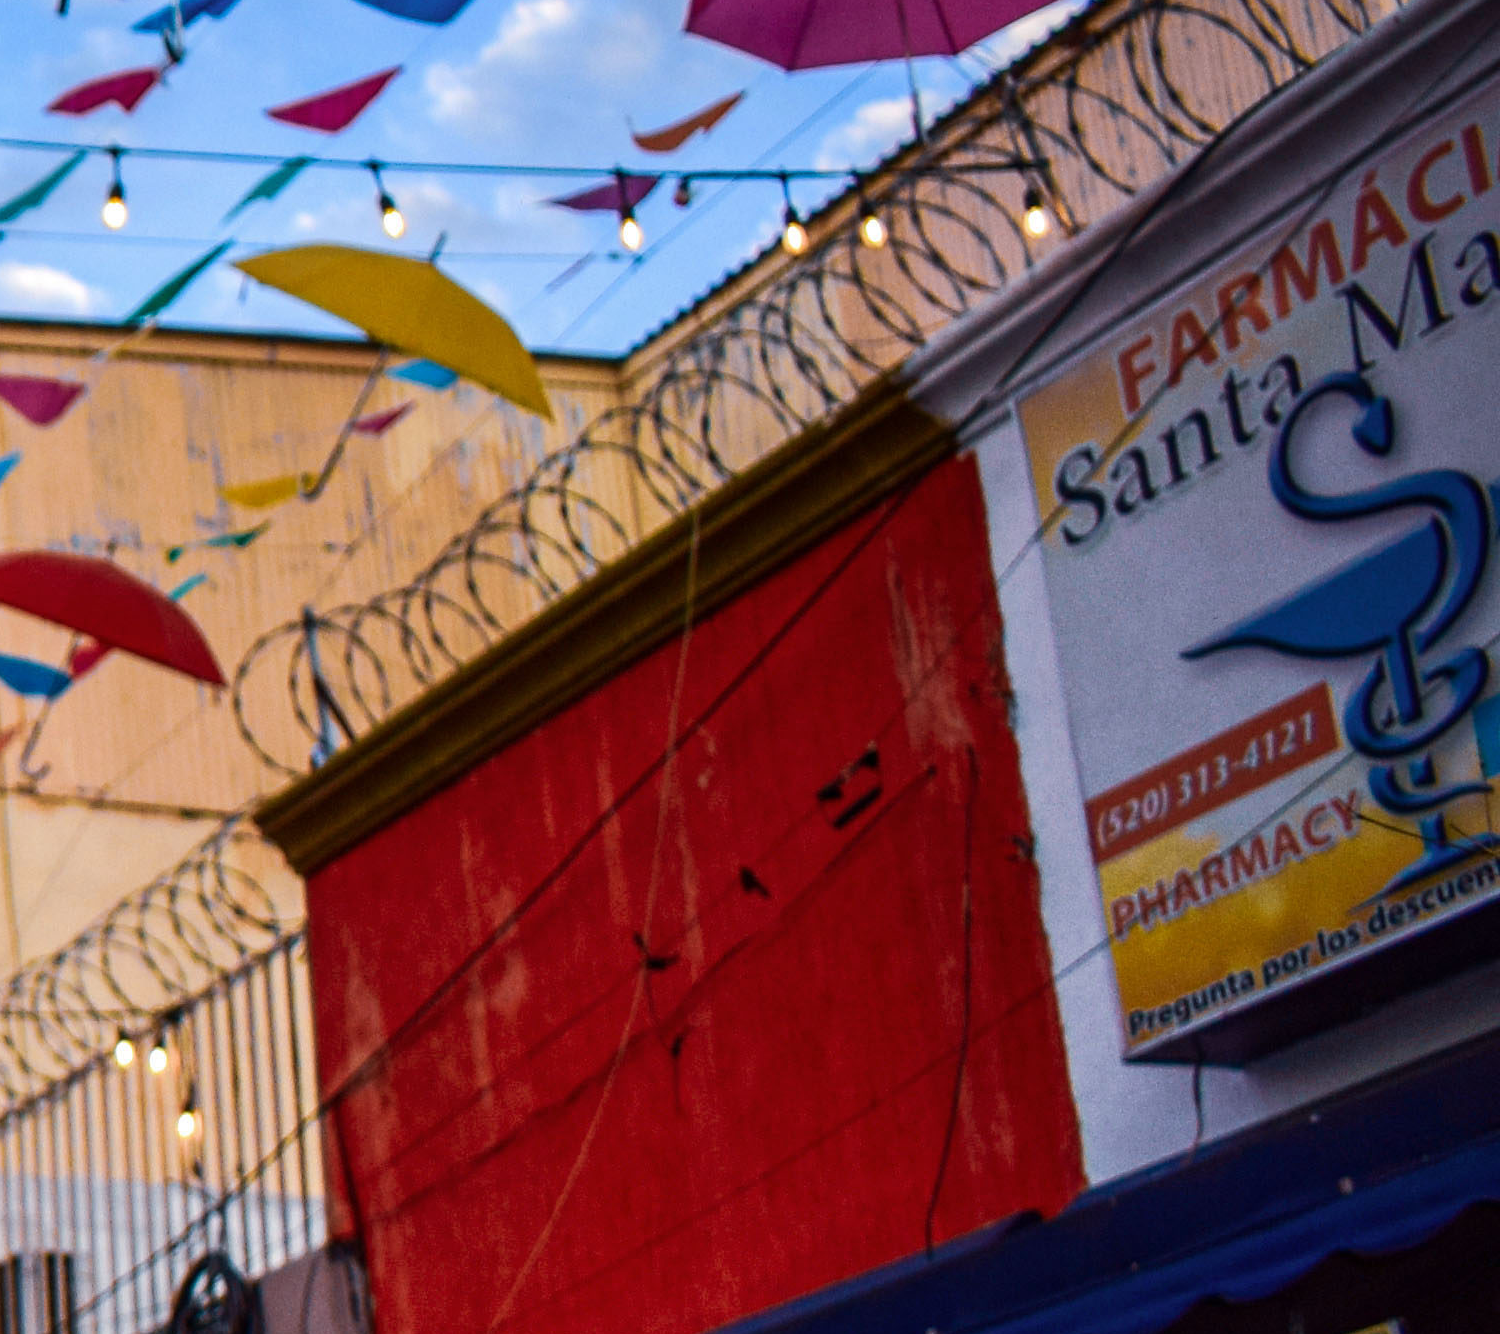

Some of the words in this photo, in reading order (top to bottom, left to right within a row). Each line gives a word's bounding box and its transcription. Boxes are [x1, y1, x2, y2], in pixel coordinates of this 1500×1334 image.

[1116, 123, 1500, 414] FARMÁCI
[1053, 353, 1303, 545] Santa
[1098, 782, 1169, 848] (520)
[1176, 712, 1314, 807] 313-4121
[1111, 789, 1359, 936] PHARMACY
[1128, 968, 1256, 1035] Pregunta
[1262, 940, 1312, 987] por
[1317, 926, 1362, 957] los
